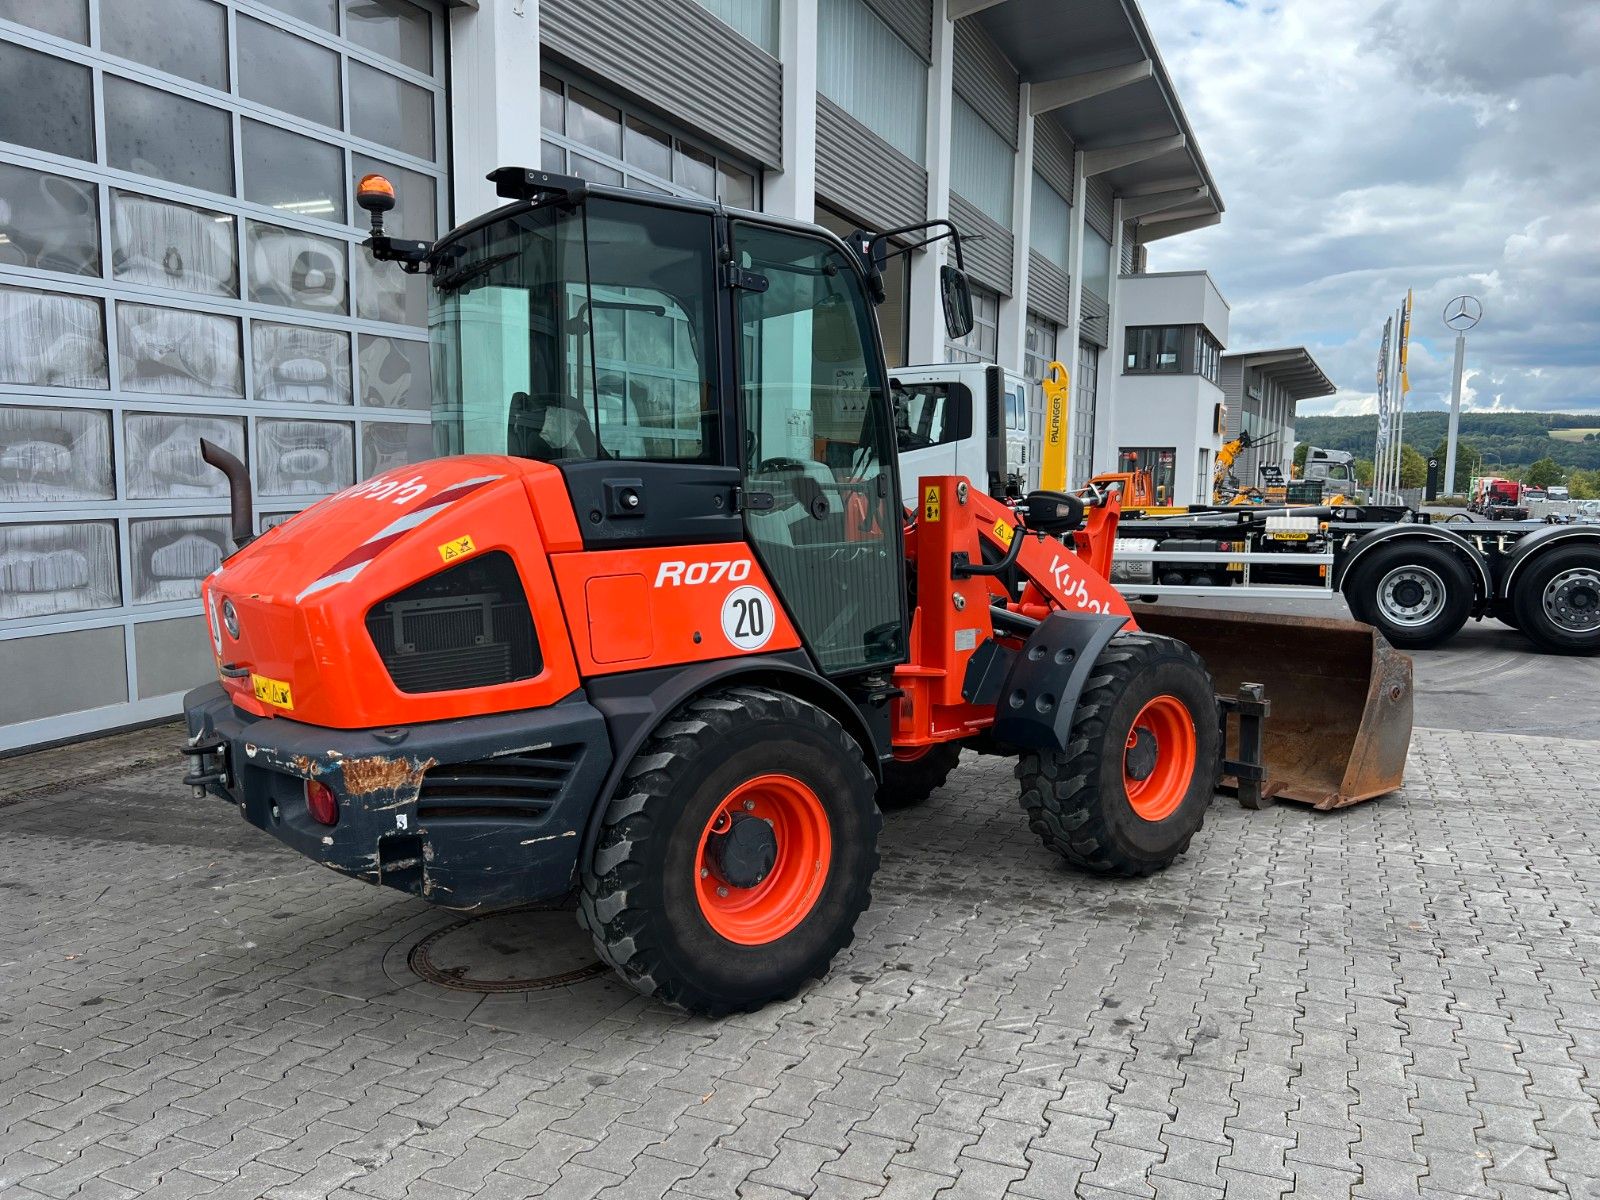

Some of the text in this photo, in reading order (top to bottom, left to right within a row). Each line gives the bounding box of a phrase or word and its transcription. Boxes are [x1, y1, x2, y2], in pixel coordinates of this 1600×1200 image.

[1050, 396, 1062, 443] PALFINGER
[1049, 554, 1110, 615] Kubot
[732, 597, 764, 638] 20
